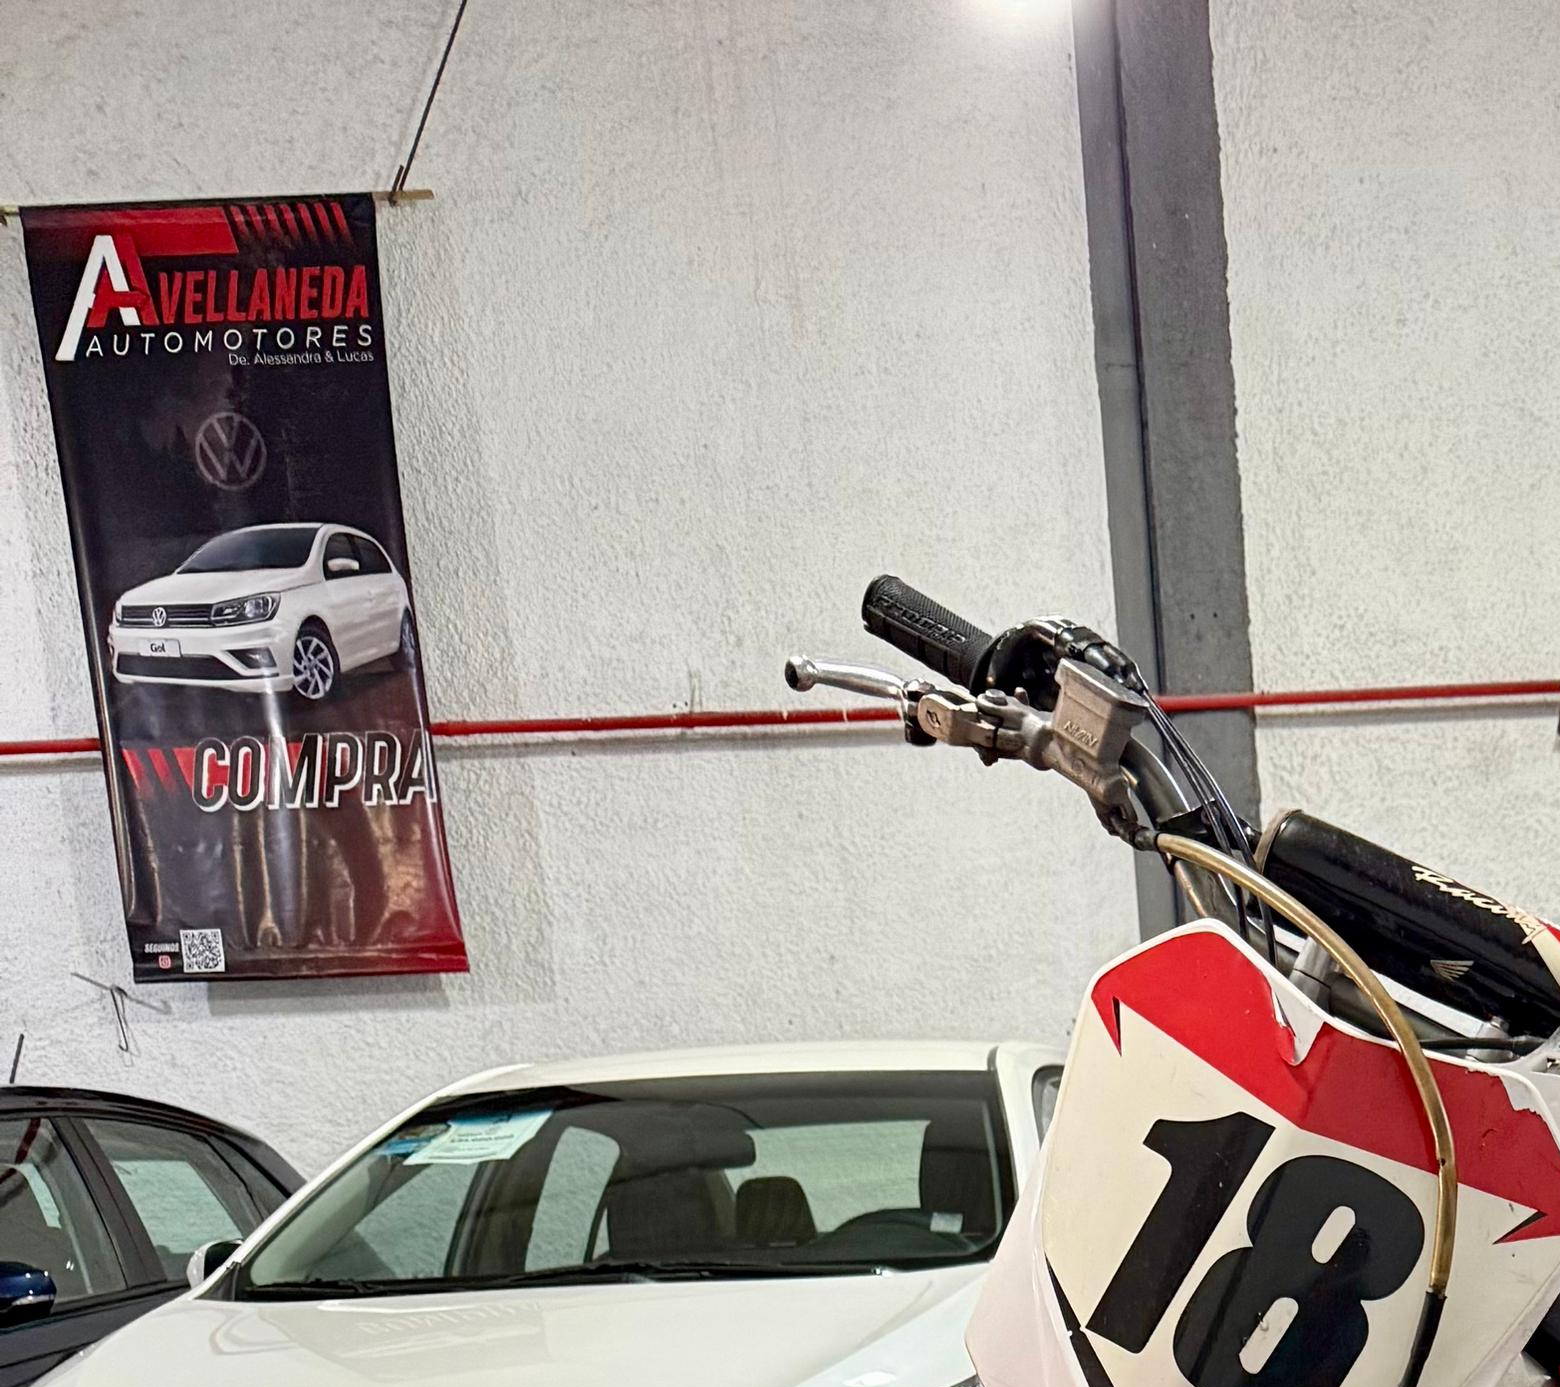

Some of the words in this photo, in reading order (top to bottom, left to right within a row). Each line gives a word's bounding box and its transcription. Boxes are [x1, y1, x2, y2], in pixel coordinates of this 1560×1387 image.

[55, 235, 369, 361] AVELLANEDA
[86, 325, 373, 357] AUTOMOTORES
[337, 350, 375, 362] Lucas
[192, 728, 437, 812] COMPRA
